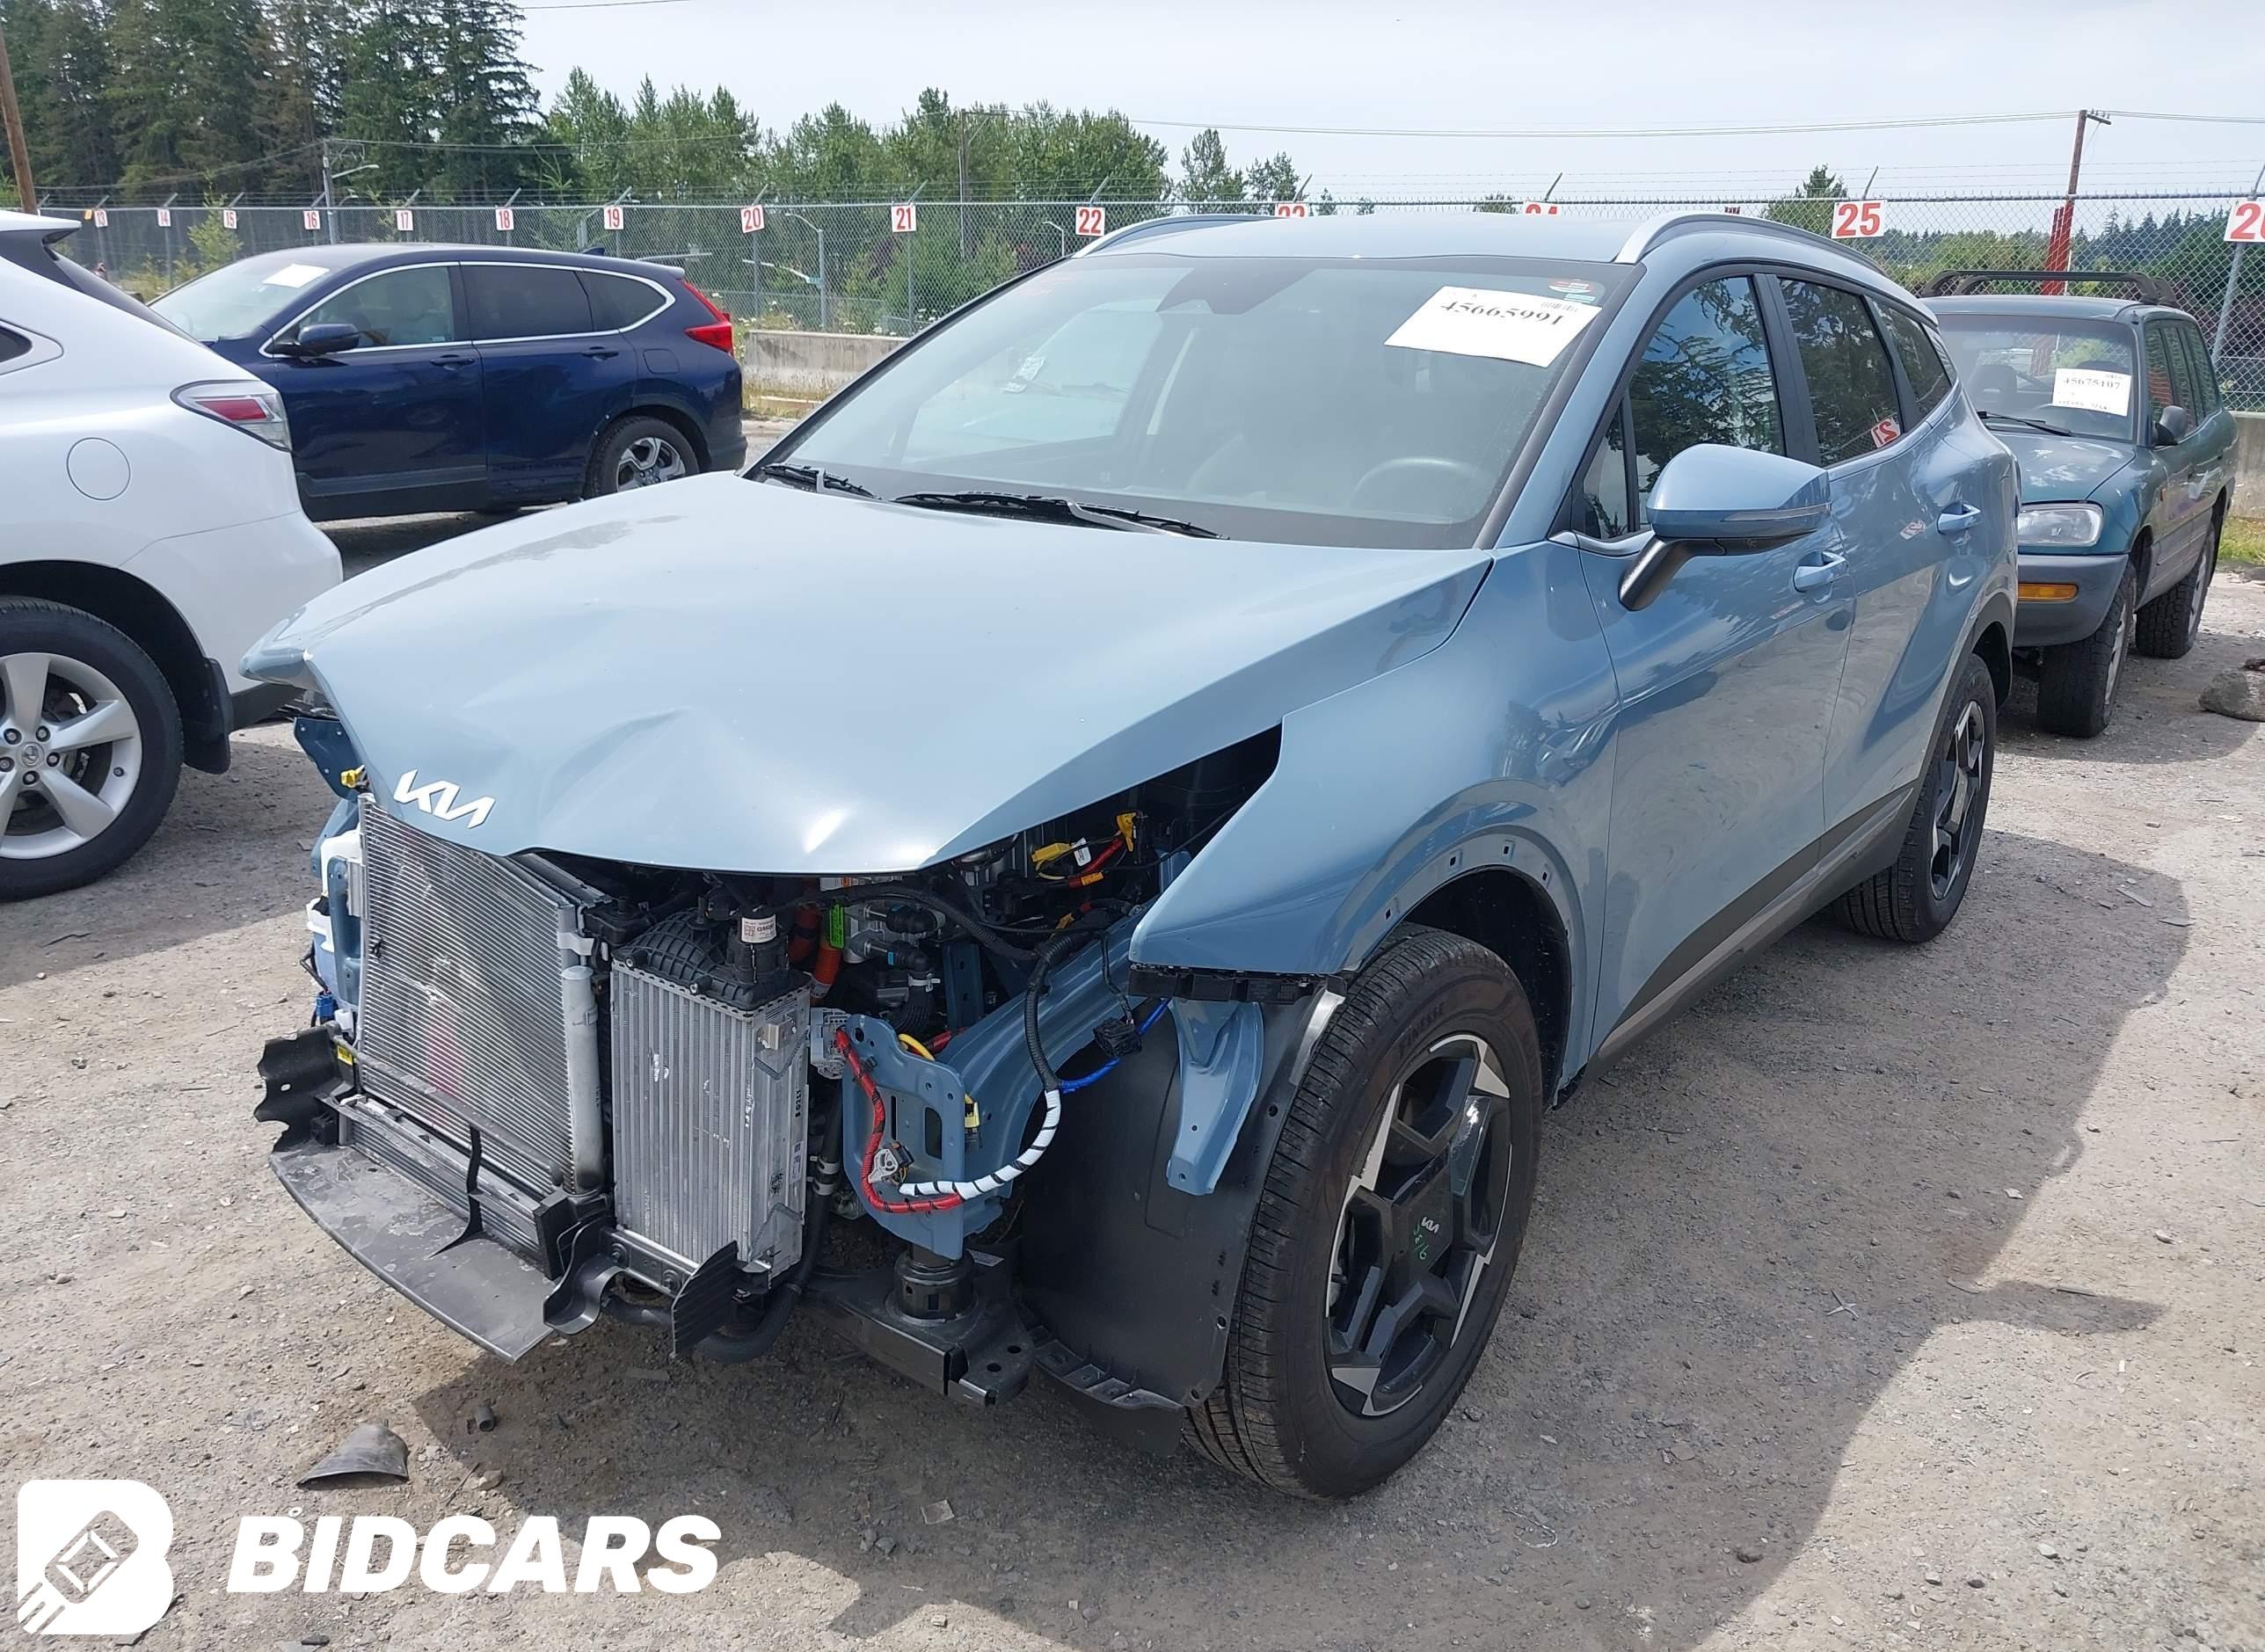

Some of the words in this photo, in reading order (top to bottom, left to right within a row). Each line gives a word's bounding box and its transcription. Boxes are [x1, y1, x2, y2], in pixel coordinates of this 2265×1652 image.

[306, 212, 317, 228] 16
[401, 212, 409, 229] 17
[499, 210, 510, 229] 18
[607, 208, 620, 229] 19
[743, 207, 761, 230] 20
[896, 207, 913, 230] 21
[1079, 208, 1102, 234] 22
[1836, 202, 1882, 237] 25
[2230, 202, 2265, 239] 2
[393, 769, 496, 829] KIA
